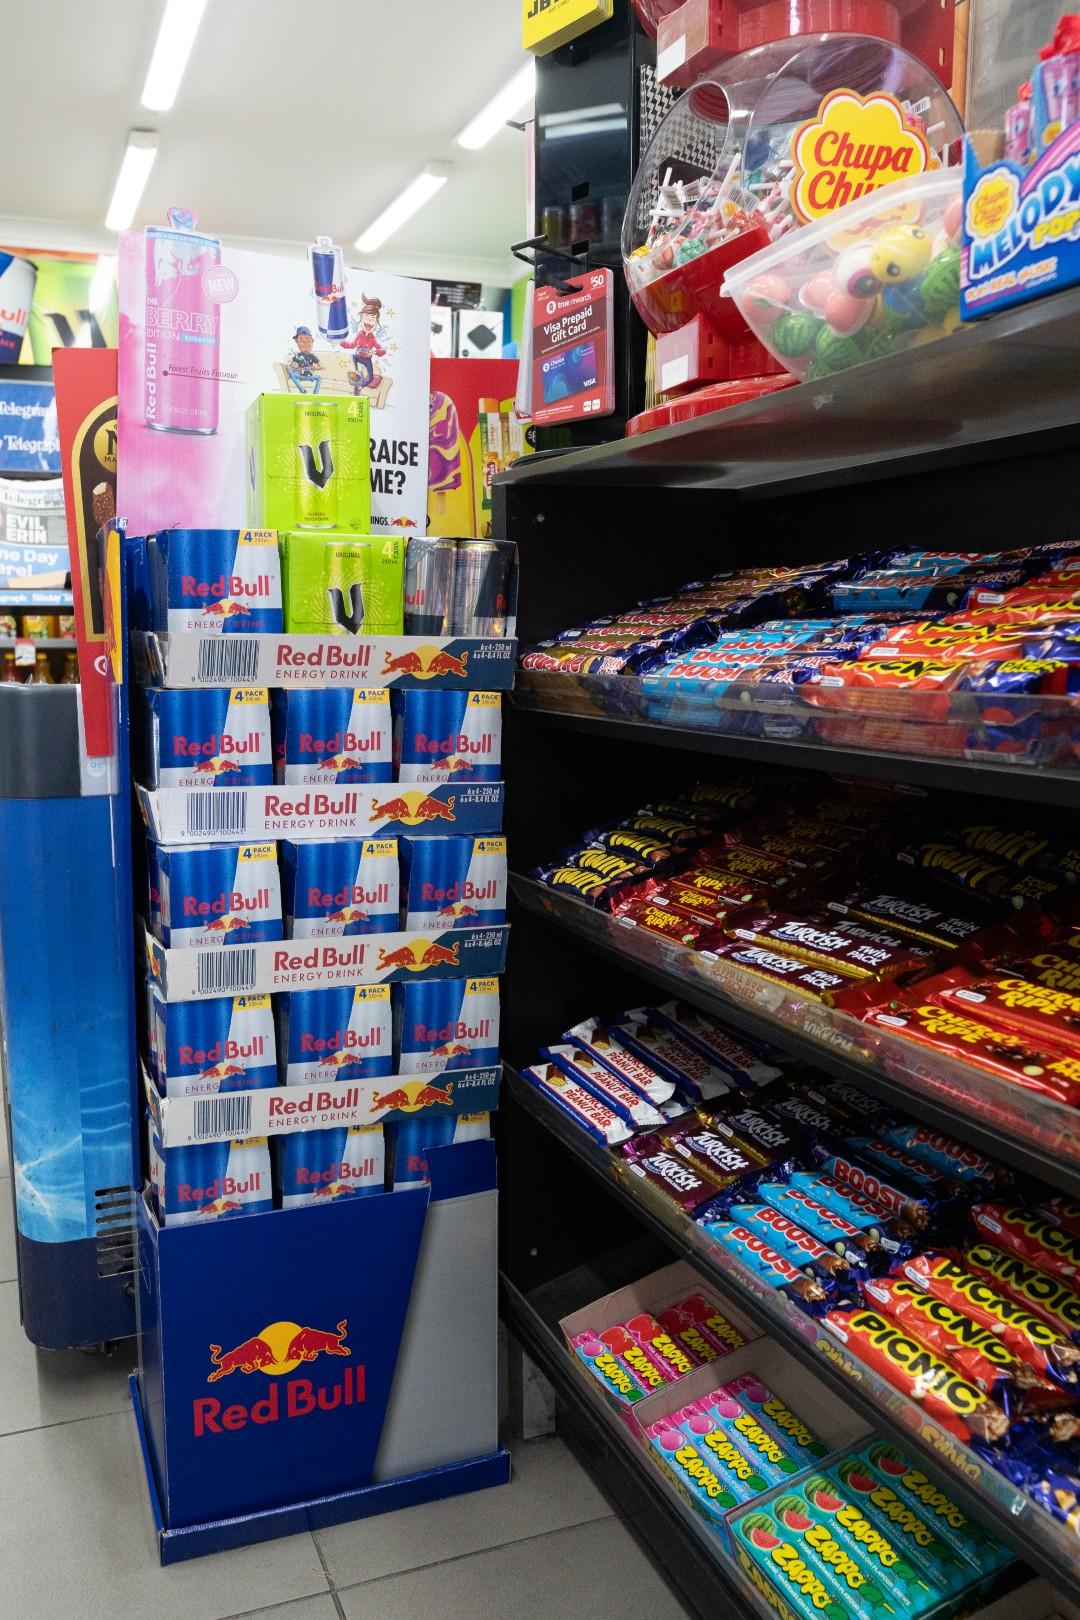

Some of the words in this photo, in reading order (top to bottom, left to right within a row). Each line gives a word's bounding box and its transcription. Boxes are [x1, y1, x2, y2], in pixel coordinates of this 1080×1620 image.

[813, 130, 914, 181] Chupa
[208, 277, 235, 294] NEW
[590, 274, 604, 288] $50
[146, 308, 219, 336] BERRY
[543, 322, 561, 335] Visa
[562, 305, 593, 327] Prepaid
[551, 329, 567, 343] Gift
[568, 319, 587, 336] Card
[145, 343, 157, 379] Bull
[168, 363, 188, 375] Forest
[190, 366, 210, 377] Fruits
[211, 368, 238, 380] Flavour
[145, 381, 157, 419] Red
[347, 401, 357, 418] 4
[298, 440, 334, 490] V
[6, 512, 45, 530] EVIL
[6, 529, 47, 544] ERIN
[244, 532, 253, 543] 4
[23, 549, 58, 565] Day
[382, 541, 393, 558] 4
[181, 575, 225, 597] Red
[229, 575, 270, 597] Bull
[328, 582, 365, 635] V
[276, 644, 323, 666] Red
[326, 645, 371, 667] Bull
[275, 669, 327, 679] ENERGY
[330, 670, 369, 679] DRINK
[234, 691, 244, 701] 4
[358, 690, 367, 700] 4
[472, 694, 480, 704] 4
[173, 735, 216, 756] Red
[220, 733, 260, 754] Bull
[299, 732, 340, 753] Red
[343, 731, 381, 752] Bull
[415, 734, 453, 753] Red
[456, 734, 492, 754] Bull
[265, 793, 310, 816] Red
[314, 792, 358, 815] Bull
[265, 819, 315, 830] ENERGY
[319, 818, 358, 828] DRINK
[243, 848, 252, 859] 4
[477, 841, 486, 851] 4
[308, 886, 348, 907] Red
[351, 883, 389, 904] Bull
[421, 882, 460, 902] Red
[462, 880, 497, 900] Bull
[693, 876, 724, 891] RIPE
[183, 892, 226, 916] Red
[229, 888, 270, 911] Bull
[868, 894, 942, 921] TURKISH
[644, 906, 684, 926] CHERRY
[645, 915, 668, 929] RIPE
[948, 918, 980, 932] TWIN
[777, 921, 853, 949] TURKISH
[935, 922, 970, 938] PACK
[274, 948, 319, 971] Red
[322, 944, 365, 967] Bull
[739, 946, 809, 972] TURKISH
[846, 951, 882, 967] PACK
[856, 945, 892, 960] TWIN
[274, 971, 323, 984] ENERGY
[327, 968, 364, 979] DRINK
[469, 982, 478, 992] 4
[798, 974, 832, 990] PACK
[810, 970, 843, 986] TWIN
[238, 997, 246, 1007] 4
[247, 994, 266, 1002] PACK
[998, 990, 1061, 1015] RIPE
[414, 1022, 451, 1042] Red
[454, 1019, 490, 1039] Bull
[916, 1005, 1030, 1046] CHERRY
[919, 1018, 986, 1044] RIPE
[179, 1042, 221, 1065] Red
[224, 1036, 264, 1059] Bull
[301, 1031, 341, 1052] Red
[344, 1027, 381, 1048] Bull
[608, 1051, 638, 1075] PEANUT
[632, 1072, 653, 1087] BAR
[592, 1071, 623, 1093] PEANUT
[618, 1092, 640, 1108] BAR
[269, 1093, 313, 1116] Red
[317, 1088, 358, 1111] Bull
[564, 1089, 595, 1114] PEANUT
[590, 1112, 612, 1128] BAR
[781, 1096, 833, 1131] TURKISH
[268, 1116, 317, 1127] ENERGY
[321, 1110, 358, 1122] DRINK
[735, 1108, 791, 1148] TURKISH
[694, 1131, 750, 1171] TURKISH
[912, 1126, 990, 1178] BOOST
[296, 1163, 335, 1185] Red
[338, 1158, 374, 1180] Bull
[649, 1152, 703, 1192] TURKISH
[178, 1180, 218, 1201] Red
[222, 1173, 260, 1195] Bull
[833, 1157, 908, 1214] BOOST
[755, 1206, 828, 1259] BOOST
[730, 1226, 802, 1282] BOOST
[935, 1260, 1058, 1345] PICNIC
[894, 1282, 1014, 1363] PICNIC
[850, 1312, 983, 1413] PICNIC
[192, 1382, 279, 1437] Red
[287, 1364, 366, 1418] Bull
